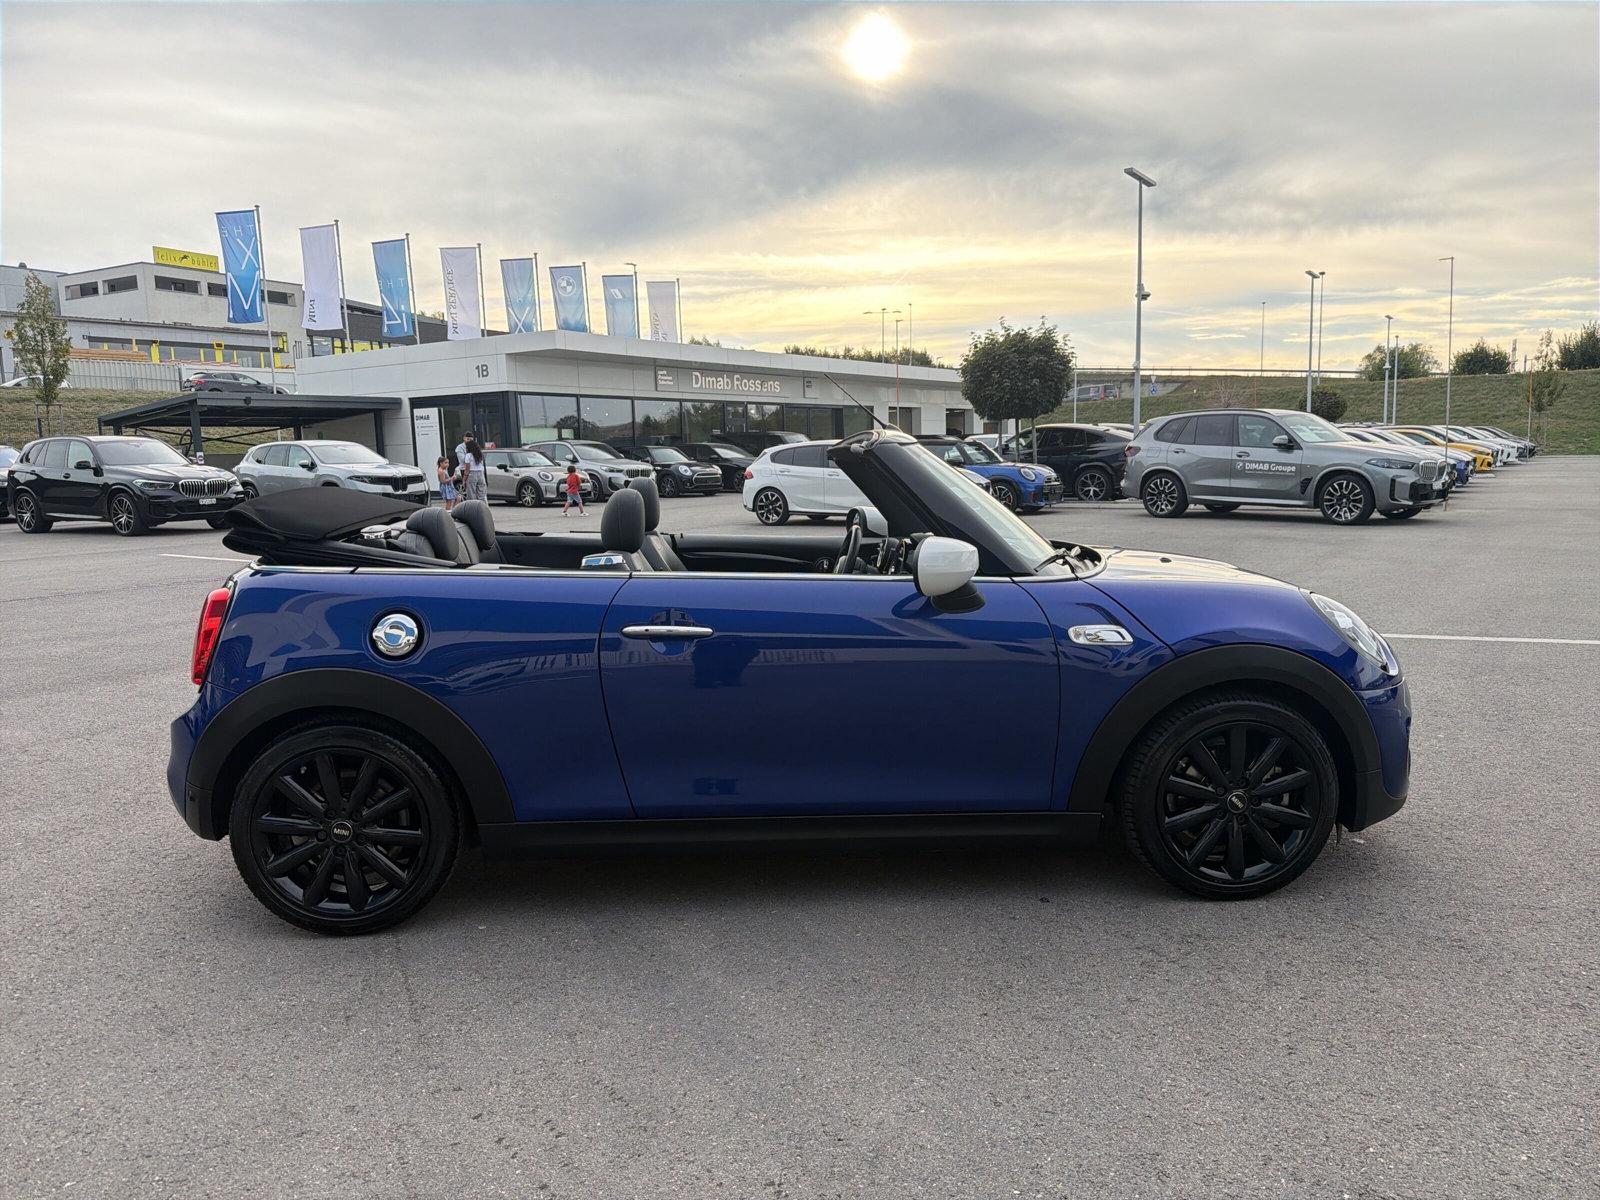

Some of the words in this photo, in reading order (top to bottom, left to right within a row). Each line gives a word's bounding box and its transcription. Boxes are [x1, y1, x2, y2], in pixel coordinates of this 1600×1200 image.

[475, 364, 489, 378] 1B
[692, 371, 732, 390] Dimab
[734, 374, 781, 392] Rossens
[1245, 462, 1269, 471] DIMAB
[1270, 464, 1296, 472] Groupe
[333, 828, 349, 836] MINI
